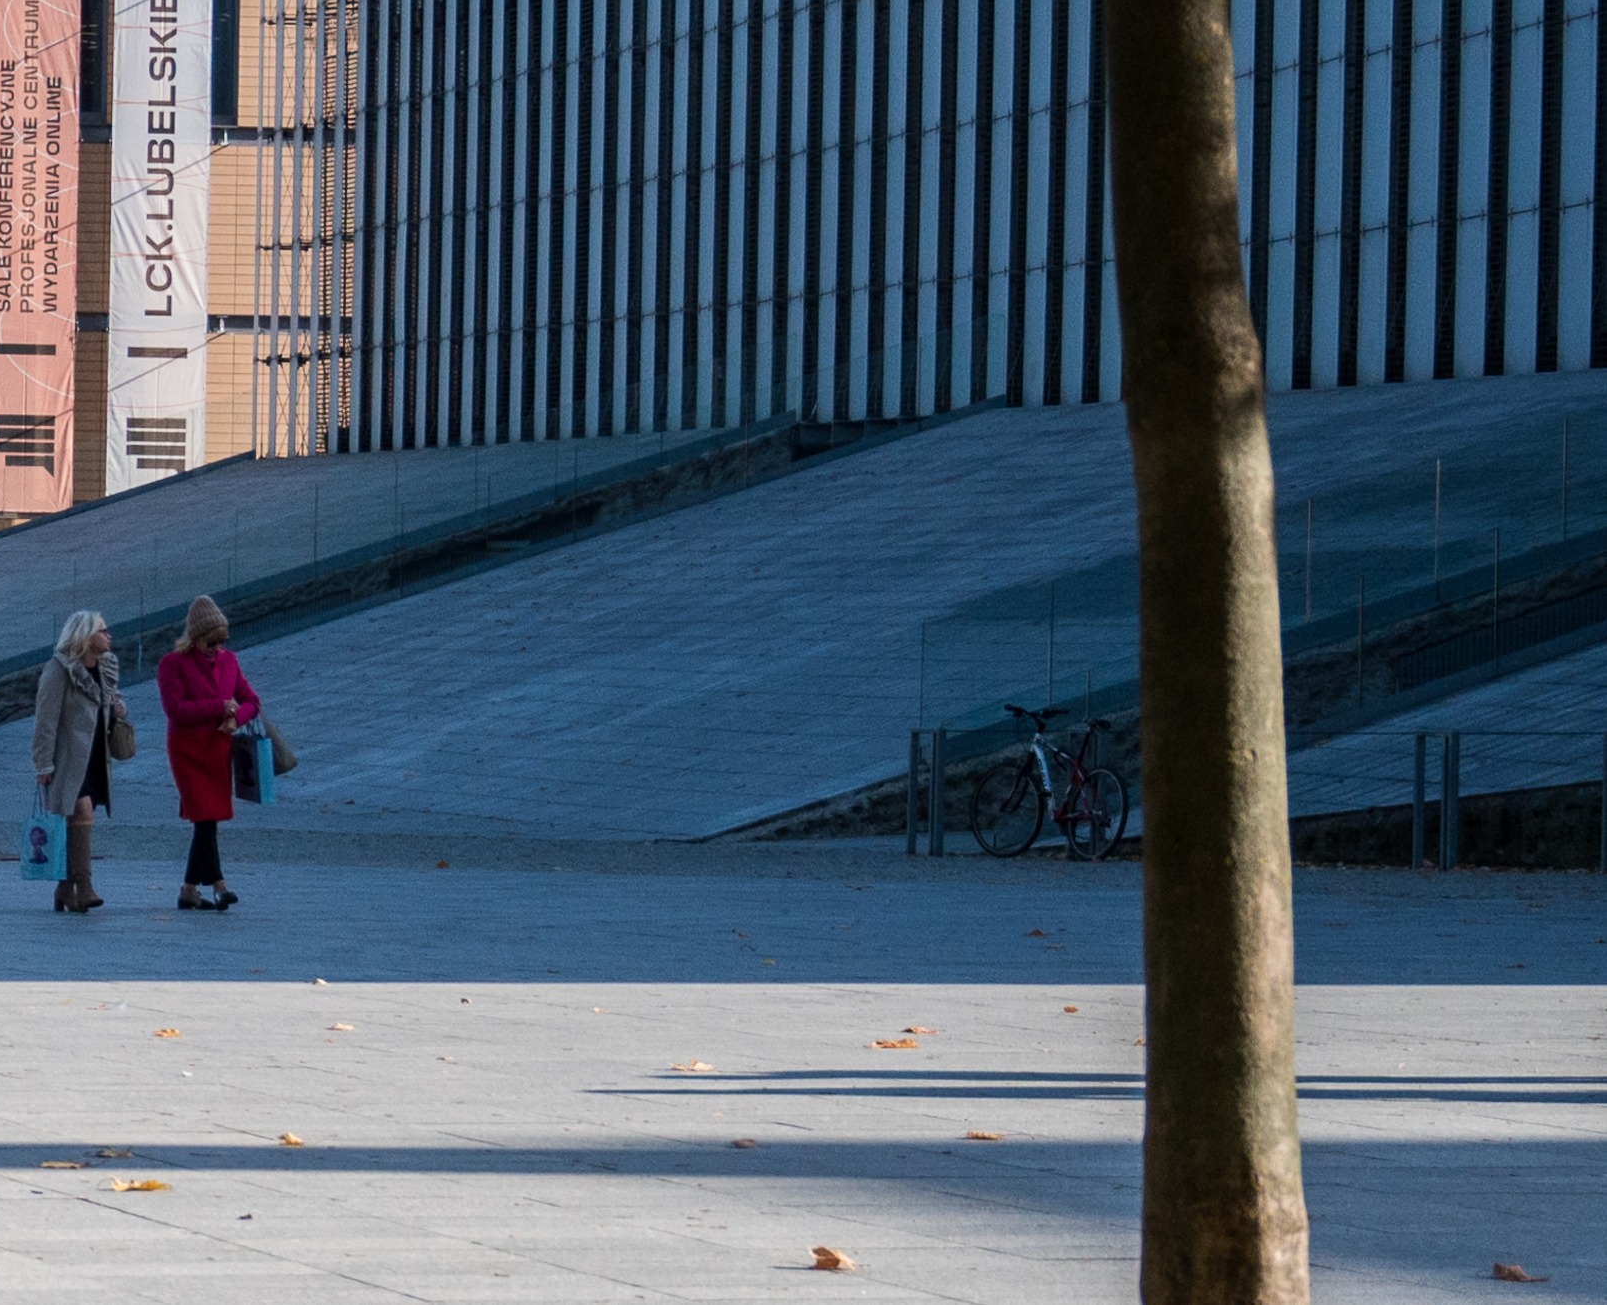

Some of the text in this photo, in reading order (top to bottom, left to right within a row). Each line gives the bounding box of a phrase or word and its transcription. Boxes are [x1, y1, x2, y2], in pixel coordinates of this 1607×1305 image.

[20, 117, 37, 313] PROFESJONALNE
[43, 76, 62, 313] WYDARZENIA ONLINE
